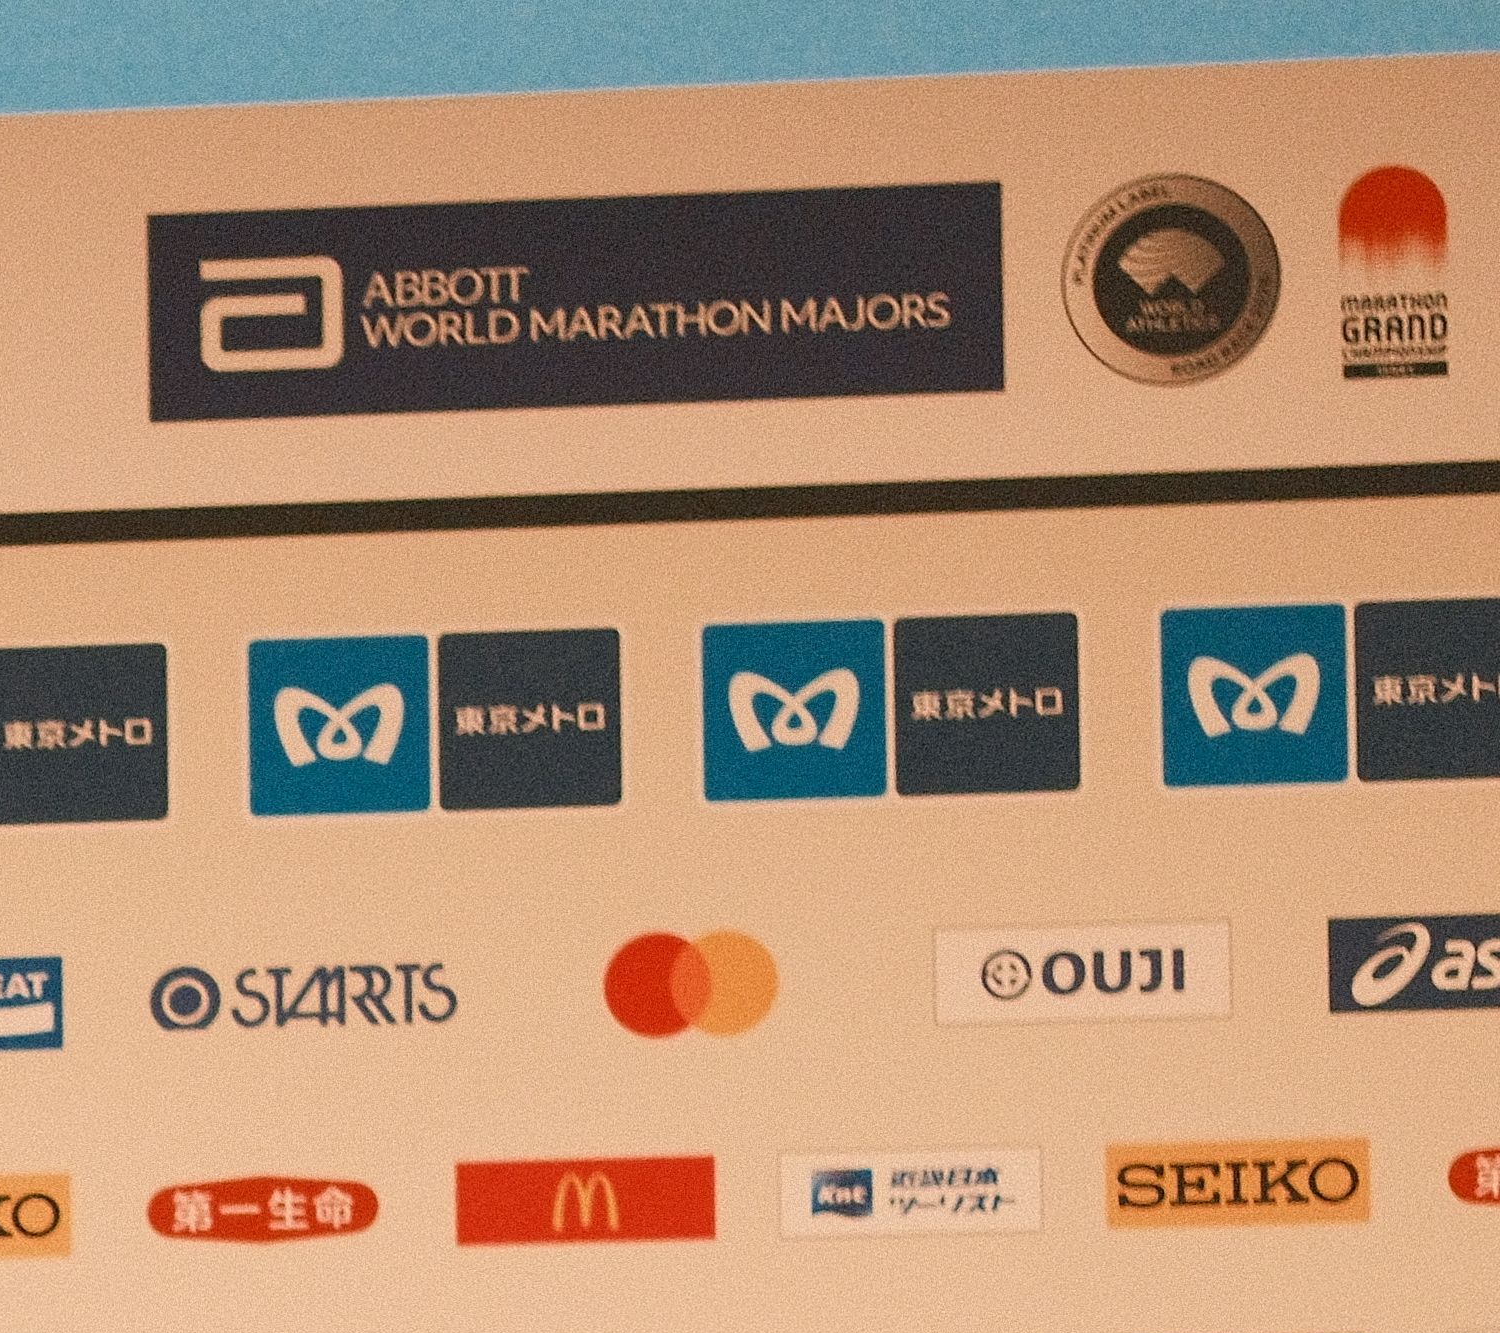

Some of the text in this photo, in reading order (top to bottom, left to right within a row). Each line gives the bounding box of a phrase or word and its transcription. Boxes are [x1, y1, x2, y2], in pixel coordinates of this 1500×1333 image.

[364, 267, 528, 307] ABBOTT
[361, 293, 950, 347] WORLD MARATHON MAJORS
[1342, 313, 1448, 343] GRAND
[913, 688, 1063, 719] 東京メトロ
[1374, 673, 1500, 705] 東京メト
[5, 718, 152, 748] 東京メトロ
[1042, 948, 1184, 995] OUJI
[1117, 1158, 1359, 1208] SEIKO
[174, 1187, 353, 1232] 第一生命
